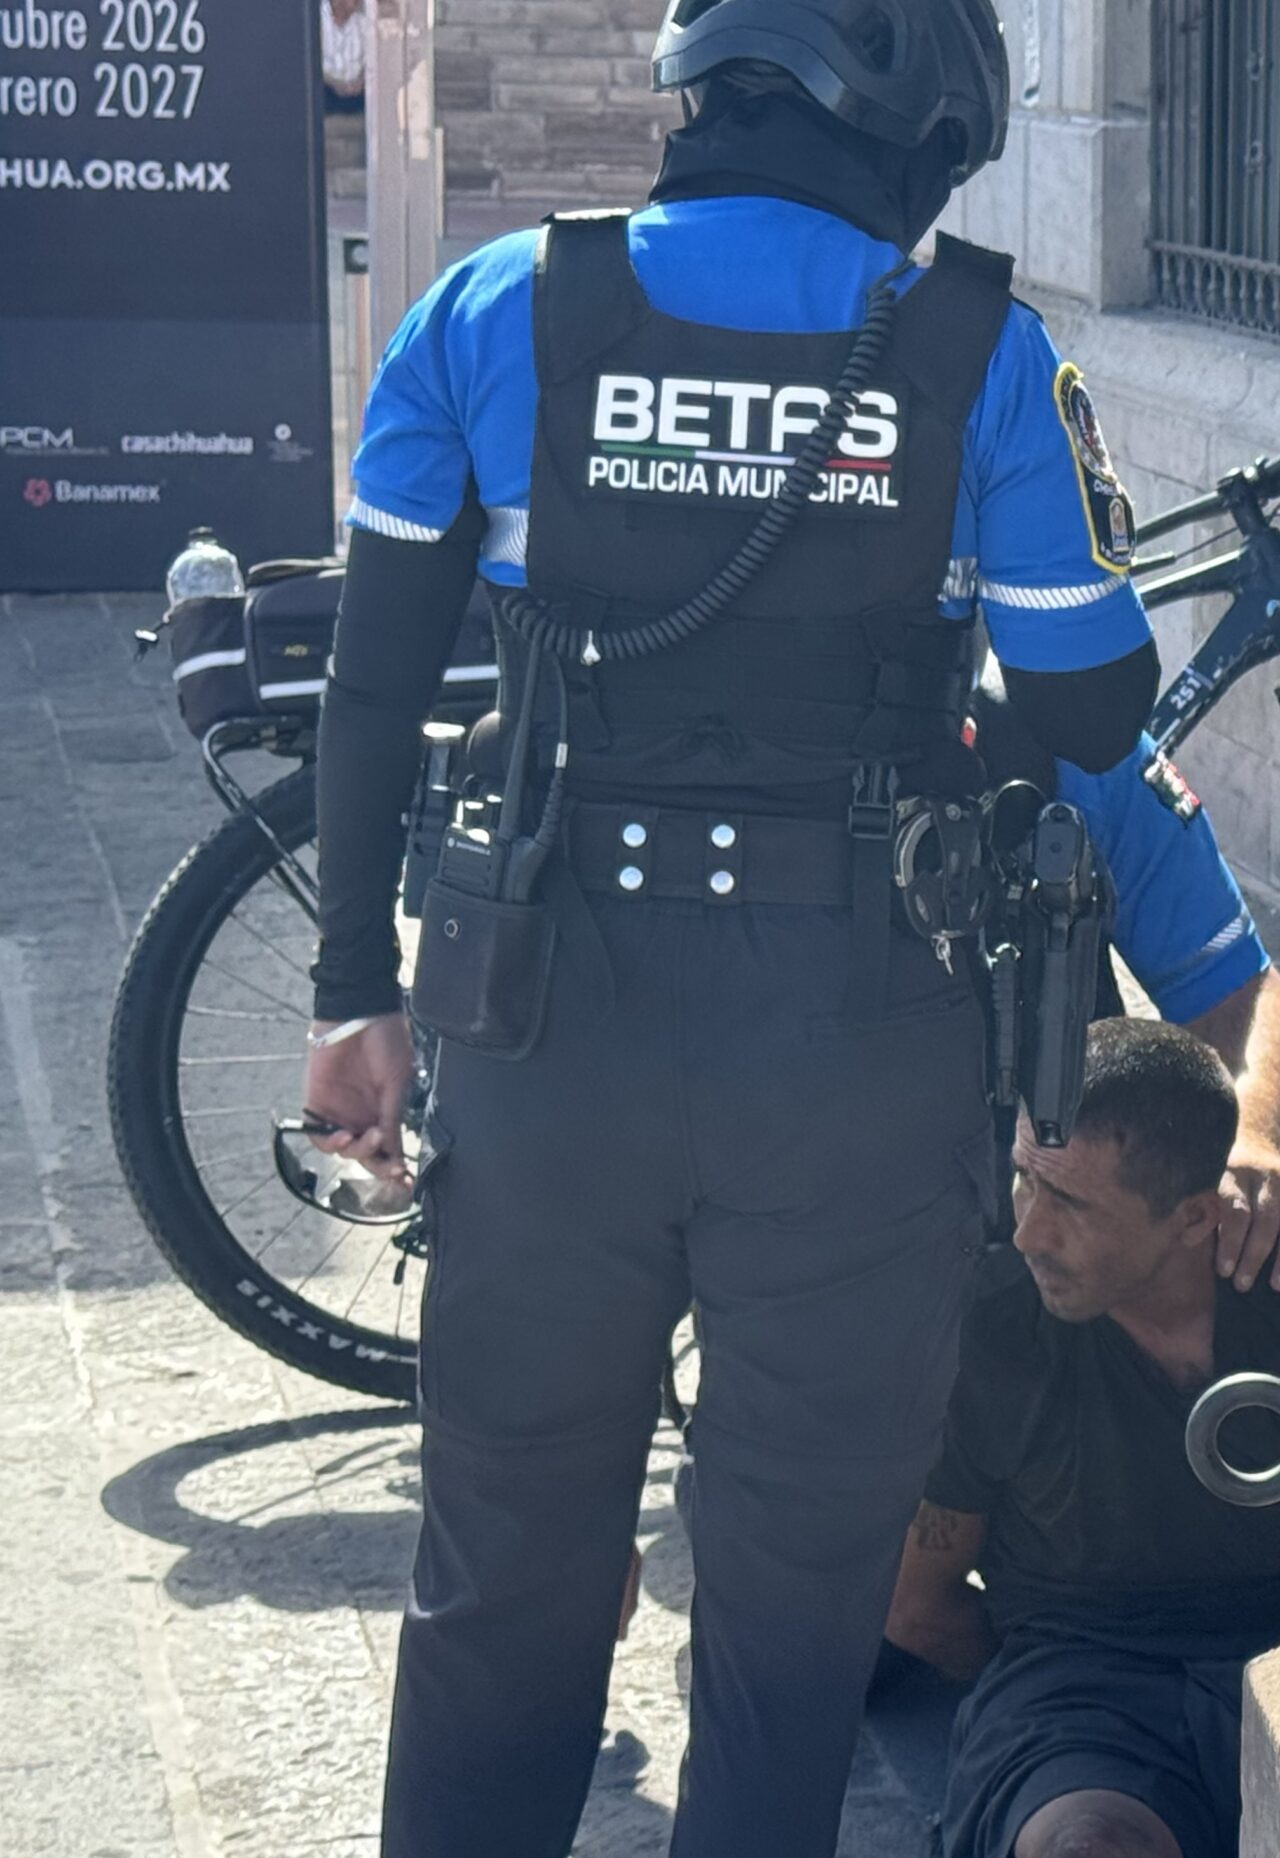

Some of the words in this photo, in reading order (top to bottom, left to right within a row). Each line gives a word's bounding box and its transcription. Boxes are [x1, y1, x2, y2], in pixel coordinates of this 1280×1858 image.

[100, 0, 206, 53] 2026
[0, 75, 77, 117] rero
[94, 62, 204, 119] 2027
[0, 158, 231, 192] HUA.ORG.MX
[55, 480, 160, 503] Banamex
[588, 456, 709, 495] POLICIA
[718, 465, 899, 508] MUNCIPAL
[236, 1278, 387, 1363] MAXXIS
